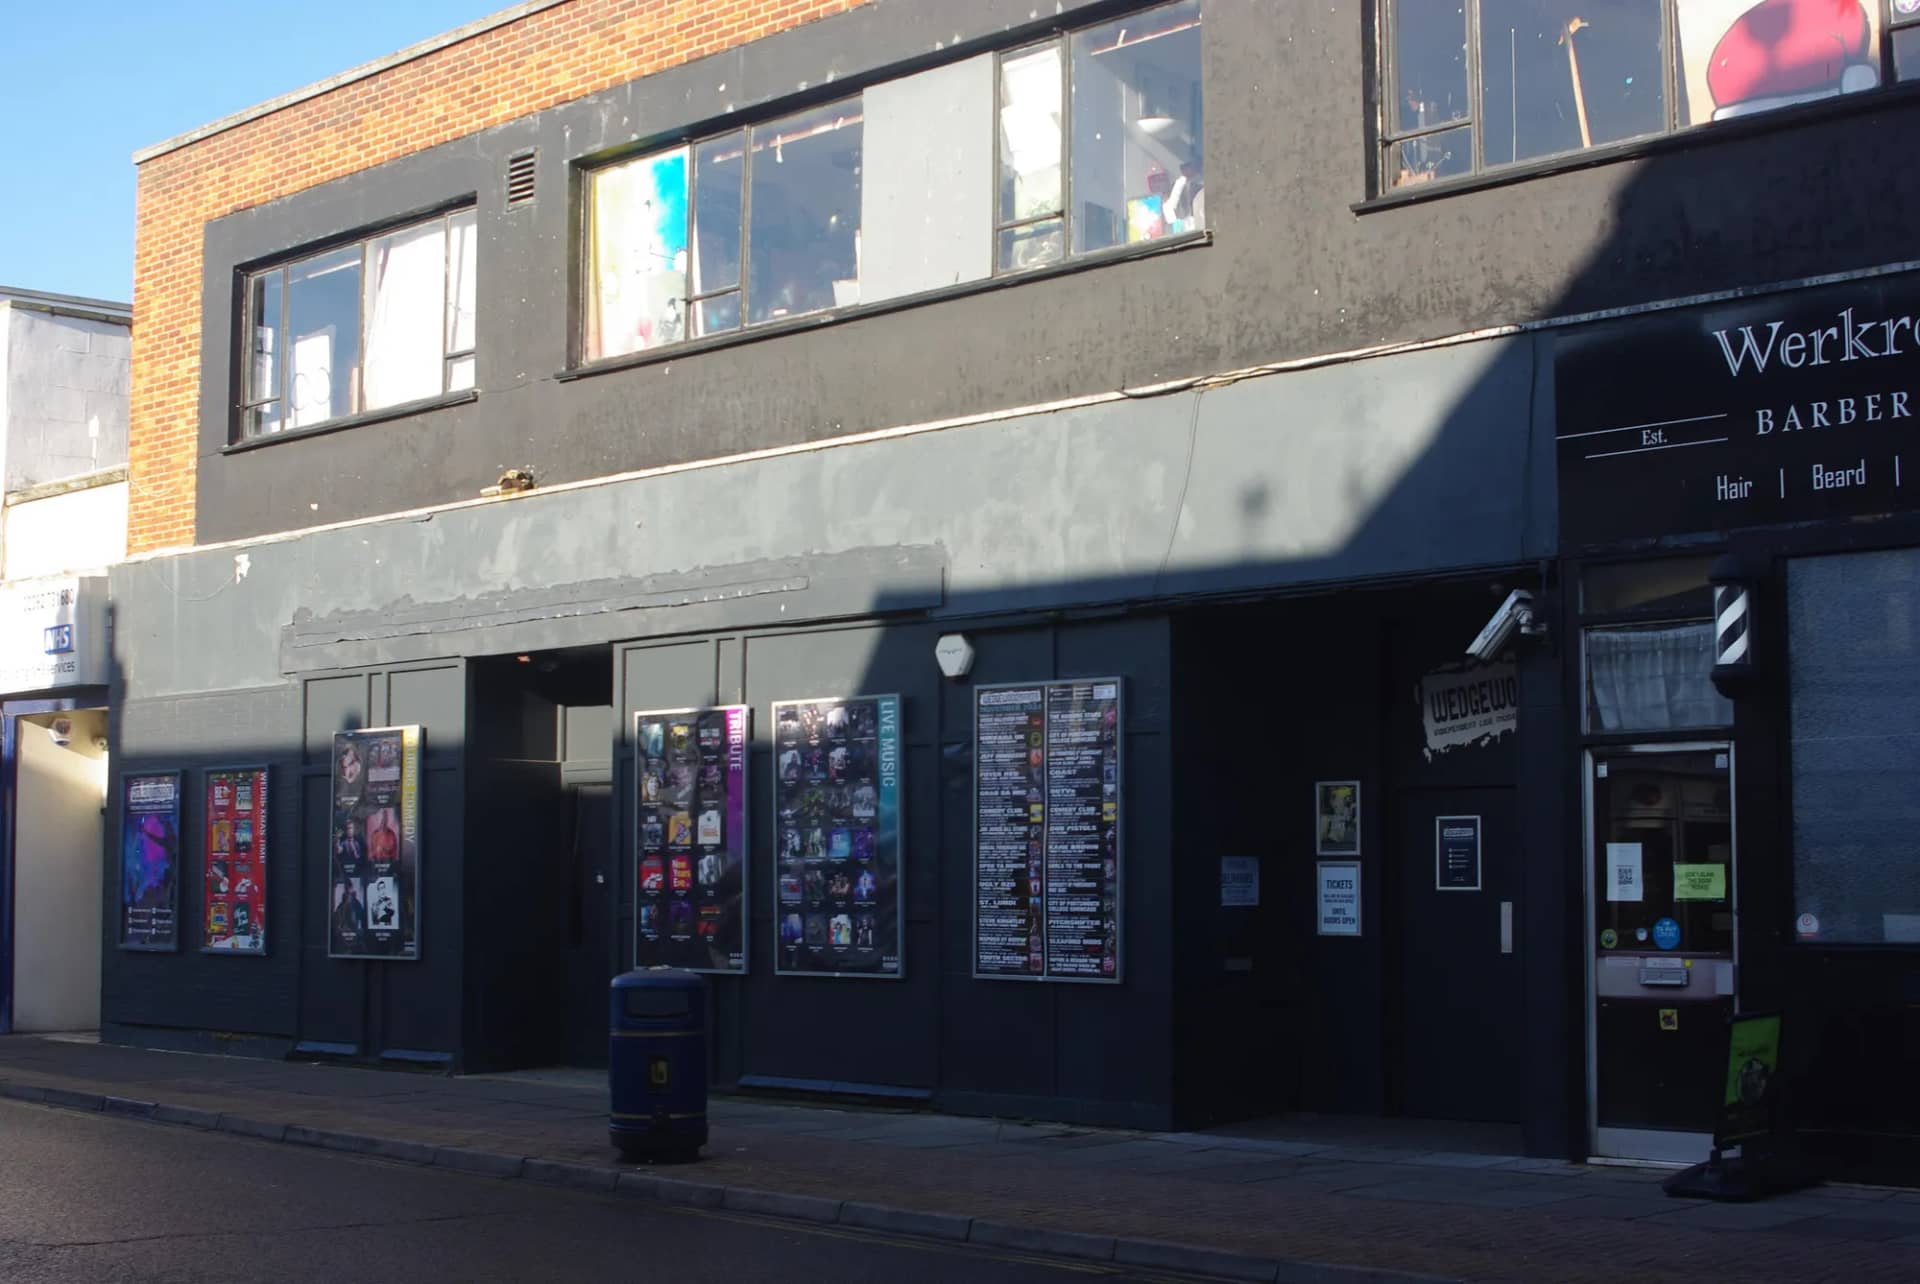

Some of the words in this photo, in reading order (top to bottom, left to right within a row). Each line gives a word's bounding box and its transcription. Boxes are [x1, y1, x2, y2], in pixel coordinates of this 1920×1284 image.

[1755, 390, 1912, 436] BARBER
[1641, 428, 1668, 446] Est.
[1716, 475, 1753, 501] Hair
[1812, 458, 1866, 491] Beard
[45, 626, 70, 651] NHS
[881, 701, 896, 733] LIVE
[729, 710, 742, 771] TRIBUTE
[881, 737, 897, 787] MUSIC
[1326, 879, 1353, 890] TICKETS
